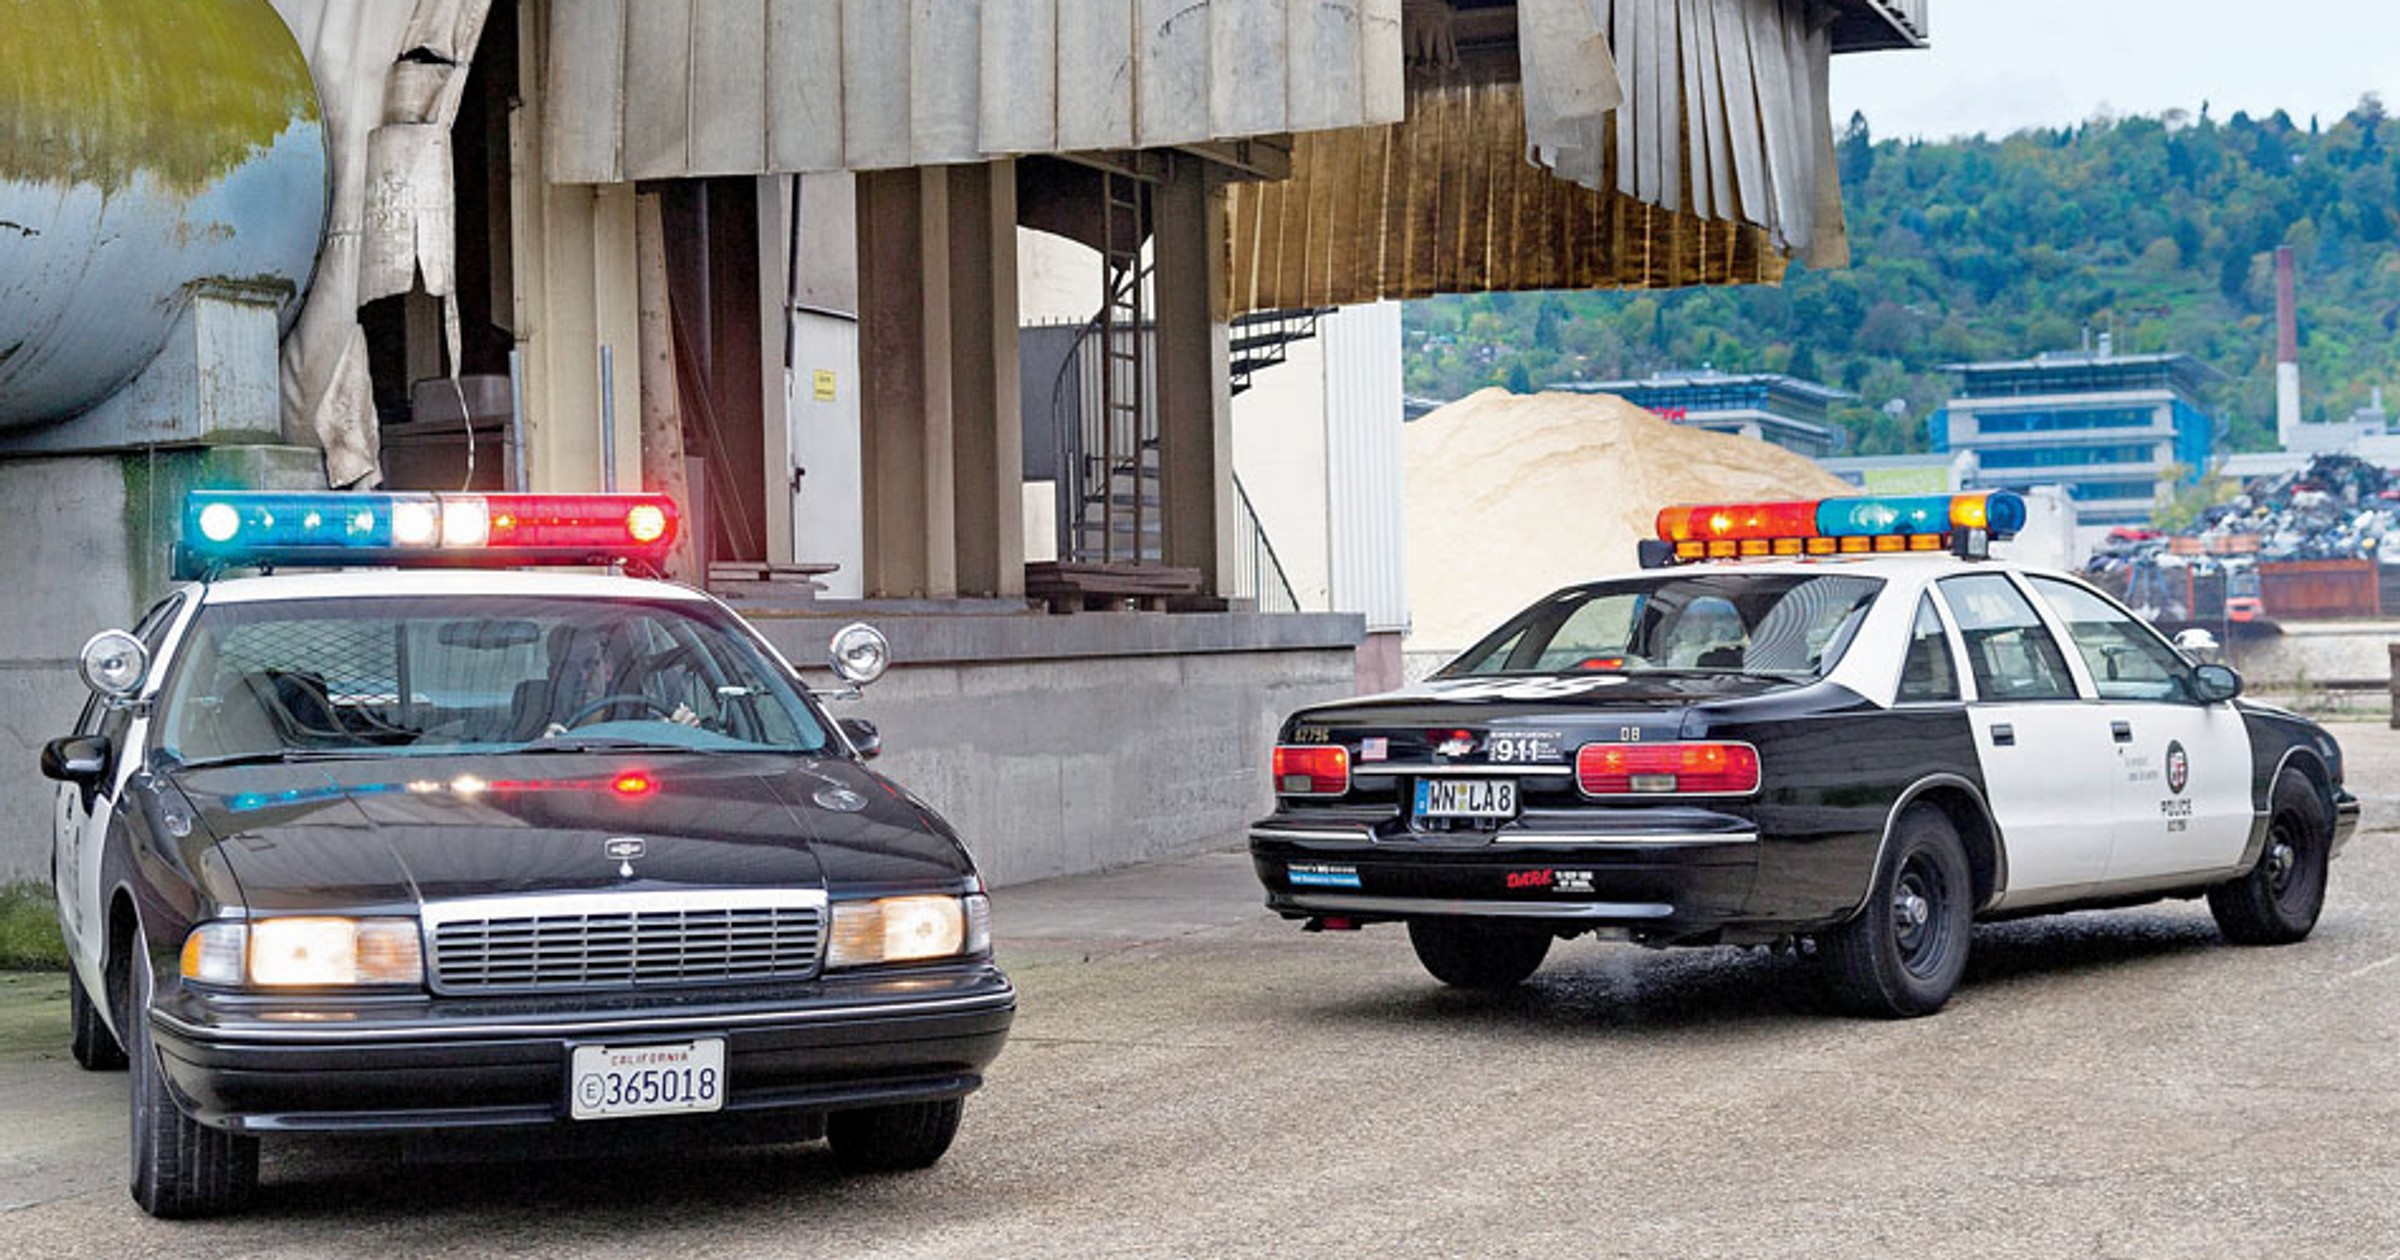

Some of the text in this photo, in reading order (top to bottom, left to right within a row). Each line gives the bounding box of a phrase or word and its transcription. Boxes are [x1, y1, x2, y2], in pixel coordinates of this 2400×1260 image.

[1429, 780, 1456, 812] WN
[2161, 799, 2192, 816] POLICE
[612, 1052, 688, 1066] CALIFORNIA
[607, 1068, 716, 1105] 365018
